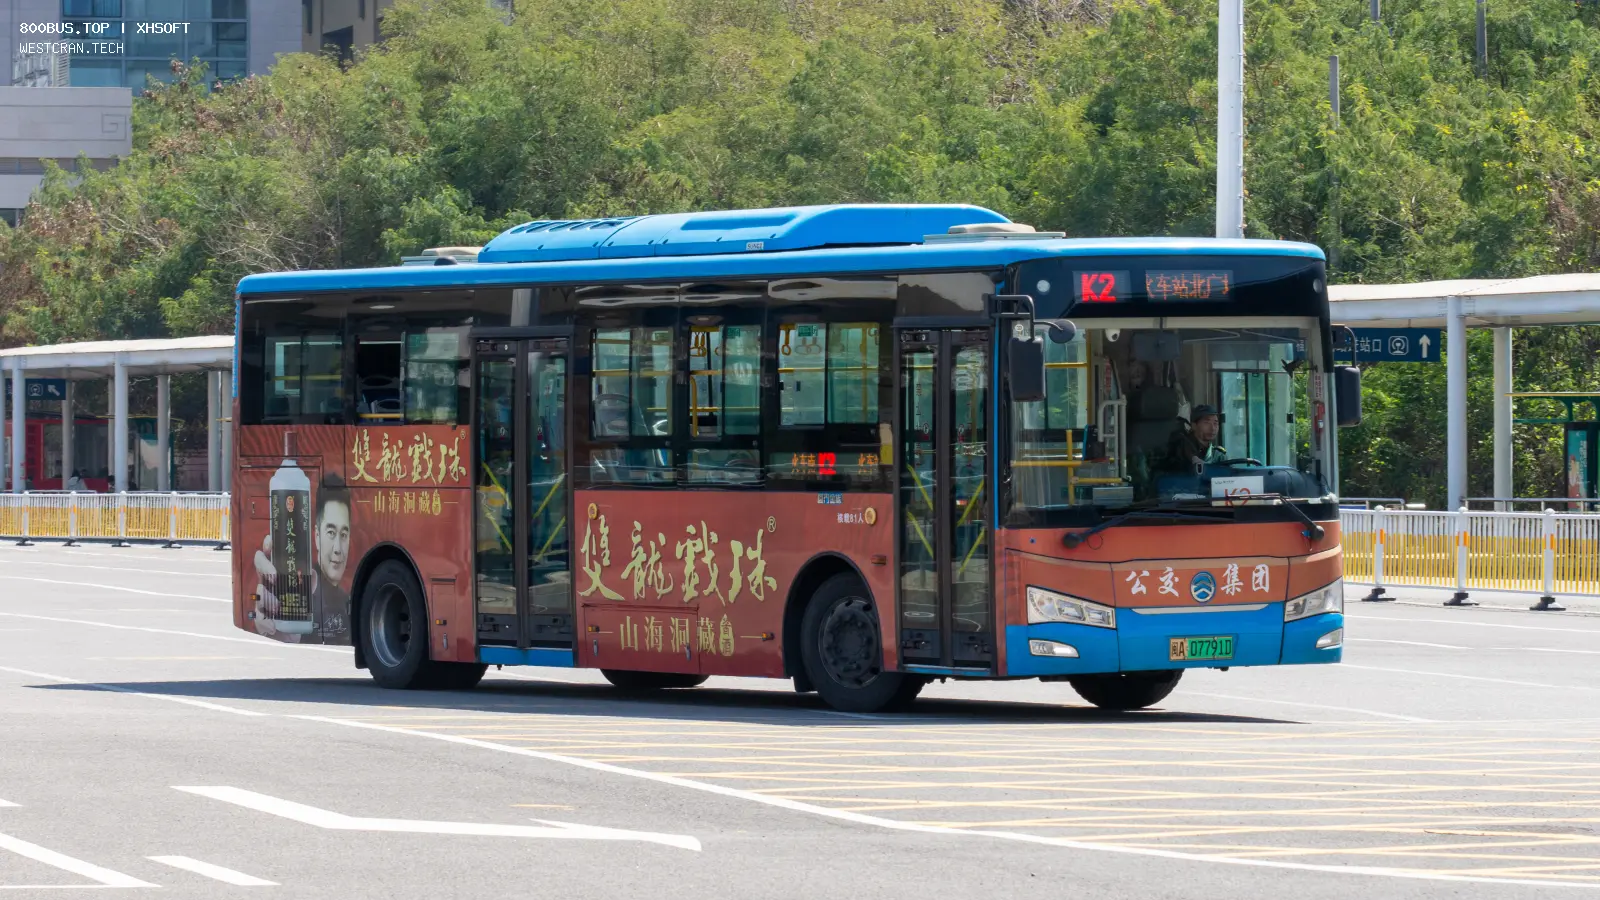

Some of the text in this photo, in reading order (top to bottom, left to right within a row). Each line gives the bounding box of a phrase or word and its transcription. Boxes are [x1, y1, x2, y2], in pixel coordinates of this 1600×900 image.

[1081, 273, 1116, 302] K2
[1125, 563, 1270, 597] 公交集团
